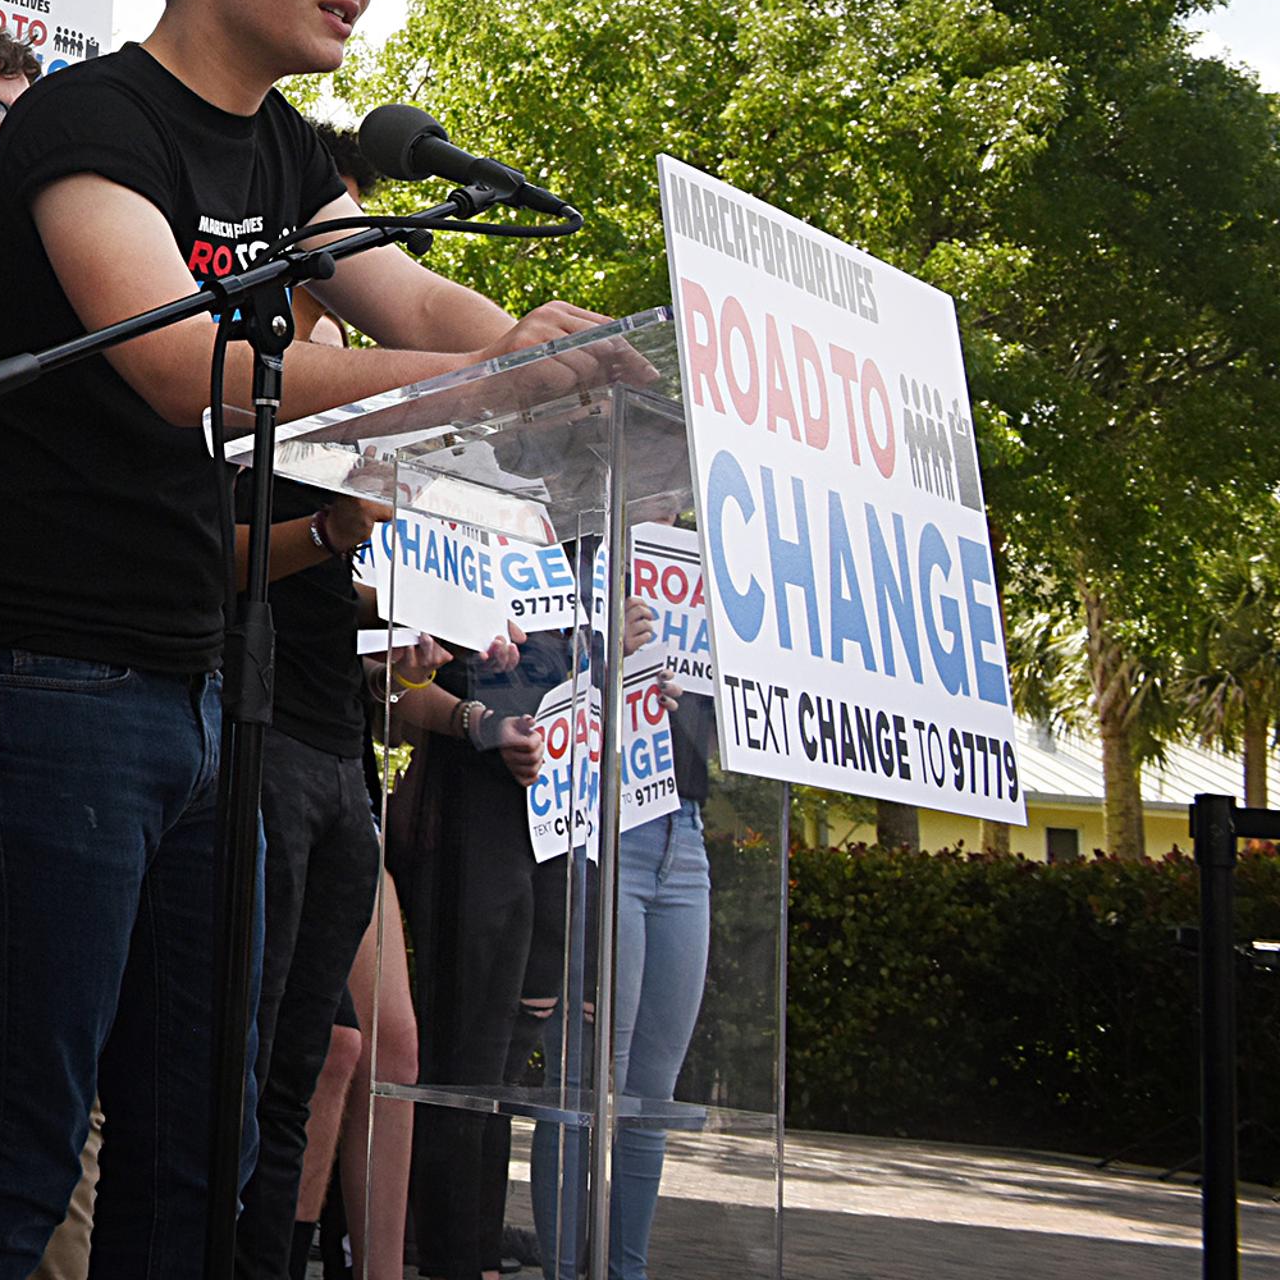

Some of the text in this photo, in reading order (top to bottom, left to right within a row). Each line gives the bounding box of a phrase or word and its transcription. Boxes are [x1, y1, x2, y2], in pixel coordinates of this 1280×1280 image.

[12, 13, 48, 47] TO
[198, 215, 234, 239] MARCH
[670, 173, 878, 324] MARCH FOR OUR LIVES
[189, 240, 233, 277] RO
[681, 277, 896, 480] ROAD TO
[634, 559, 705, 608] ROA
[706, 449, 1009, 707] CHANGE
[626, 684, 666, 732] TO
[724, 674, 1020, 804] TEXT CHANGE TO 97779
[635, 777, 675, 807] 97779
